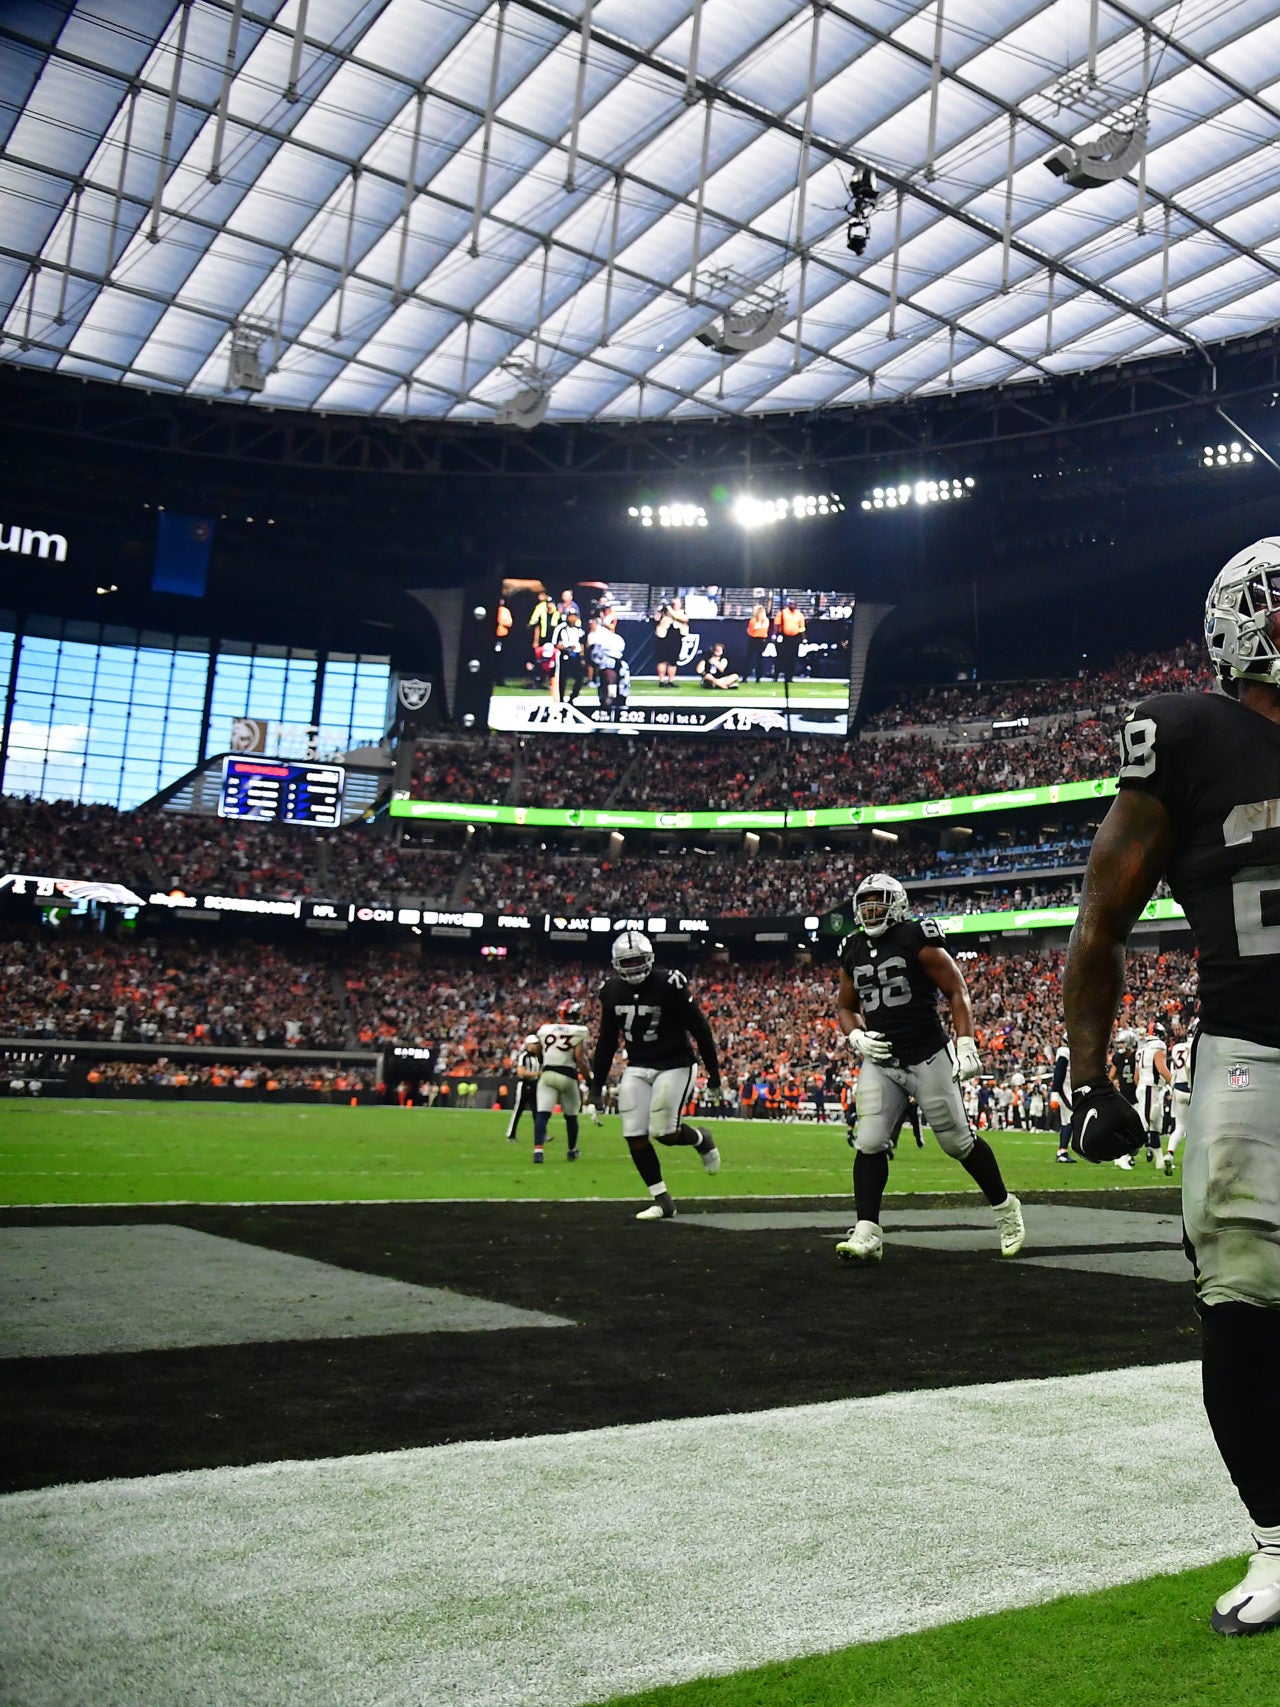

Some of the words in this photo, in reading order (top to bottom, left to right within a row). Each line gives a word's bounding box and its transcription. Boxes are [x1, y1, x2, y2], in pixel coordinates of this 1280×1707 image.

[0, 523, 68, 562] um
[619, 710, 645, 723] 2:02
[655, 713, 670, 723] 40
[699, 714, 706, 724] 7
[1119, 718, 1157, 779] 8
[314, 906, 336, 917] NFL
[498, 916, 530, 928] FINAL
[568, 919, 589, 929] JAX
[680, 919, 708, 931] FINAL
[853, 955, 912, 1013] 66
[614, 1004, 662, 1043] 77
[545, 1034, 574, 1053] 93
[1230, 1076, 1247, 1085] NFL
